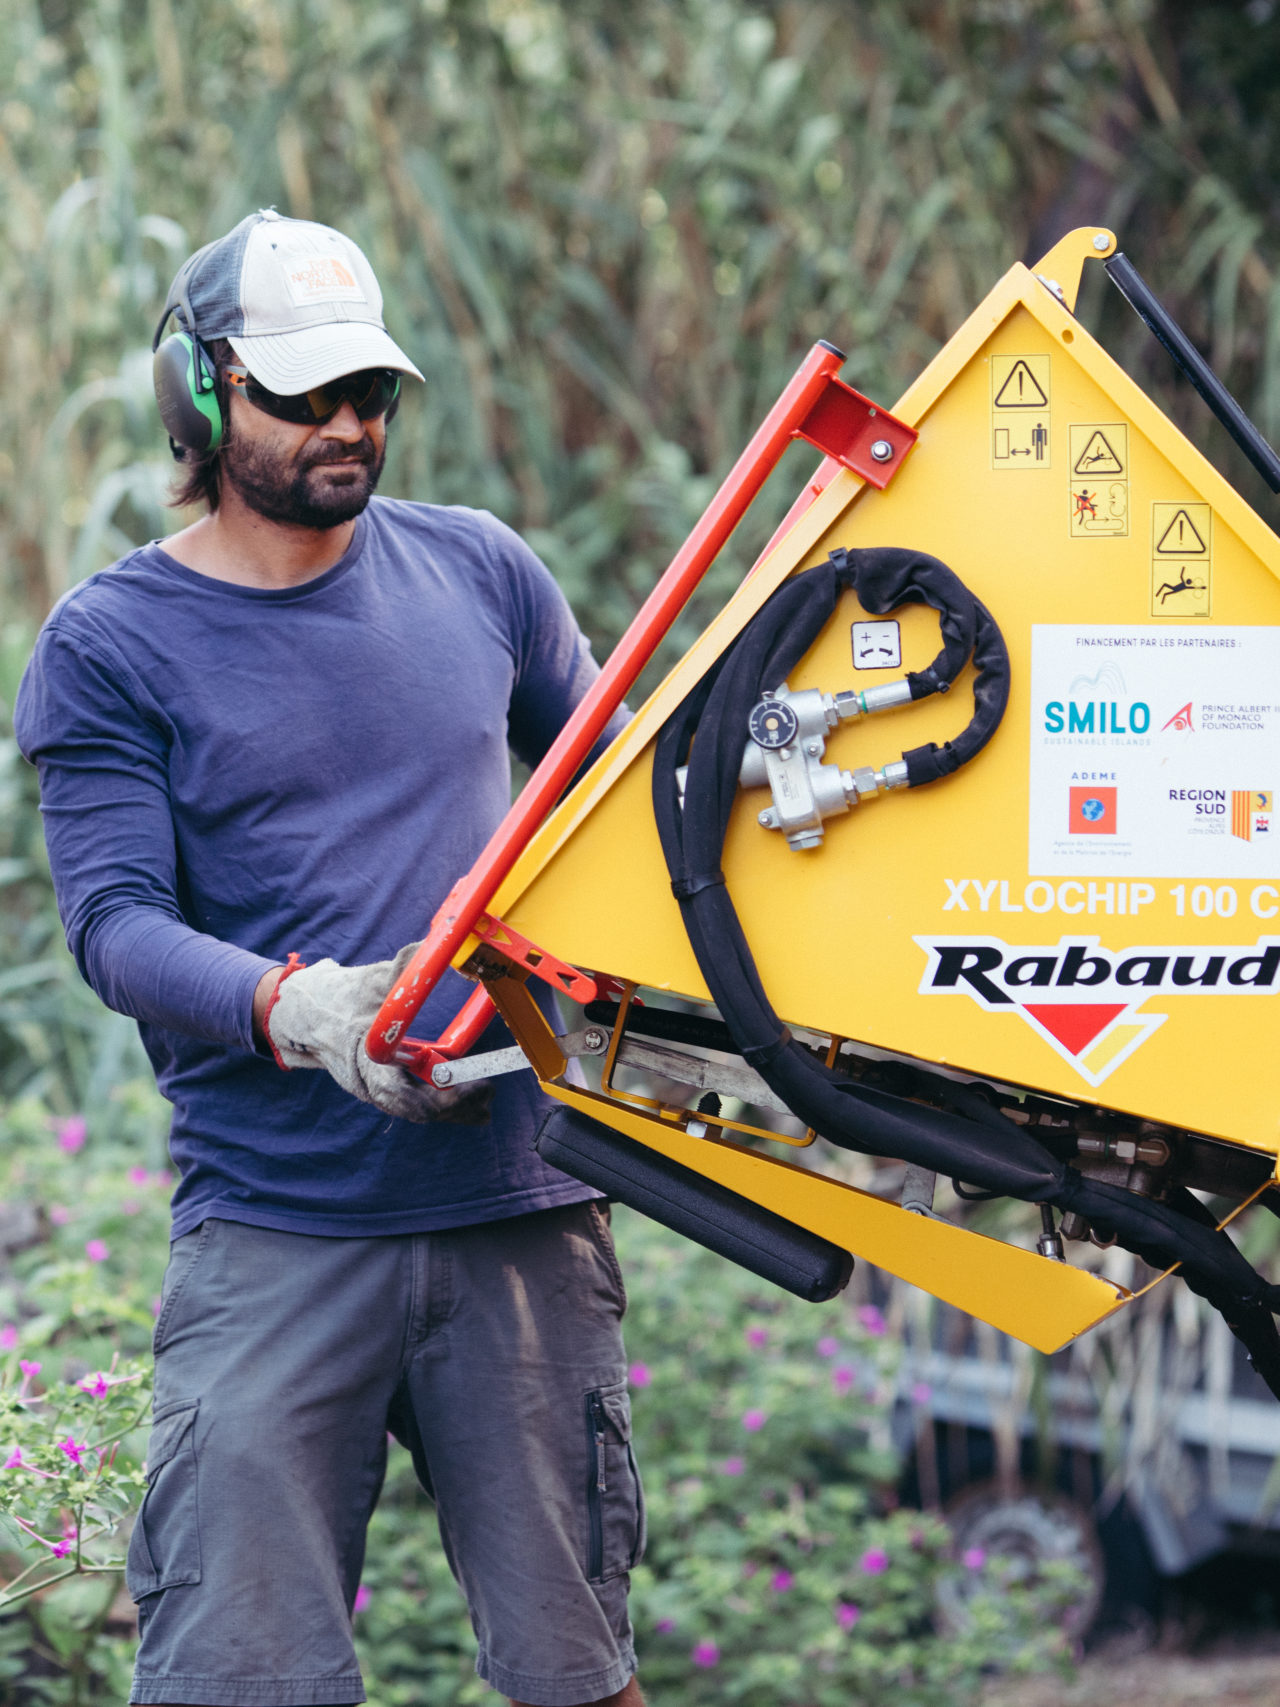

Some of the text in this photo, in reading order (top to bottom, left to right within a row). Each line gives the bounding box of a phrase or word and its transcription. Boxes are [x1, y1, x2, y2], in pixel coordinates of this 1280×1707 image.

[1076, 637, 1137, 647] FINANCEMENT
[1140, 638, 1156, 647] PAR
[1160, 638, 1174, 648] LES
[1177, 638, 1236, 648] PARTENAIRES
[1238, 705, 1271, 713] ALBERT
[1044, 701, 1151, 734] SMILO
[1202, 713, 1214, 721] OF
[1202, 722, 1265, 730] FOUNDATION
[1044, 737, 1151, 746] SUSTAINABLE ISLANDS
[1071, 772, 1117, 780] ADEME
[1169, 789, 1226, 801] REGION
[1195, 803, 1226, 814] SUD
[942, 879, 1279, 919] XYLOCHIP 100 C
[931, 946, 1280, 1004] Rabaud
